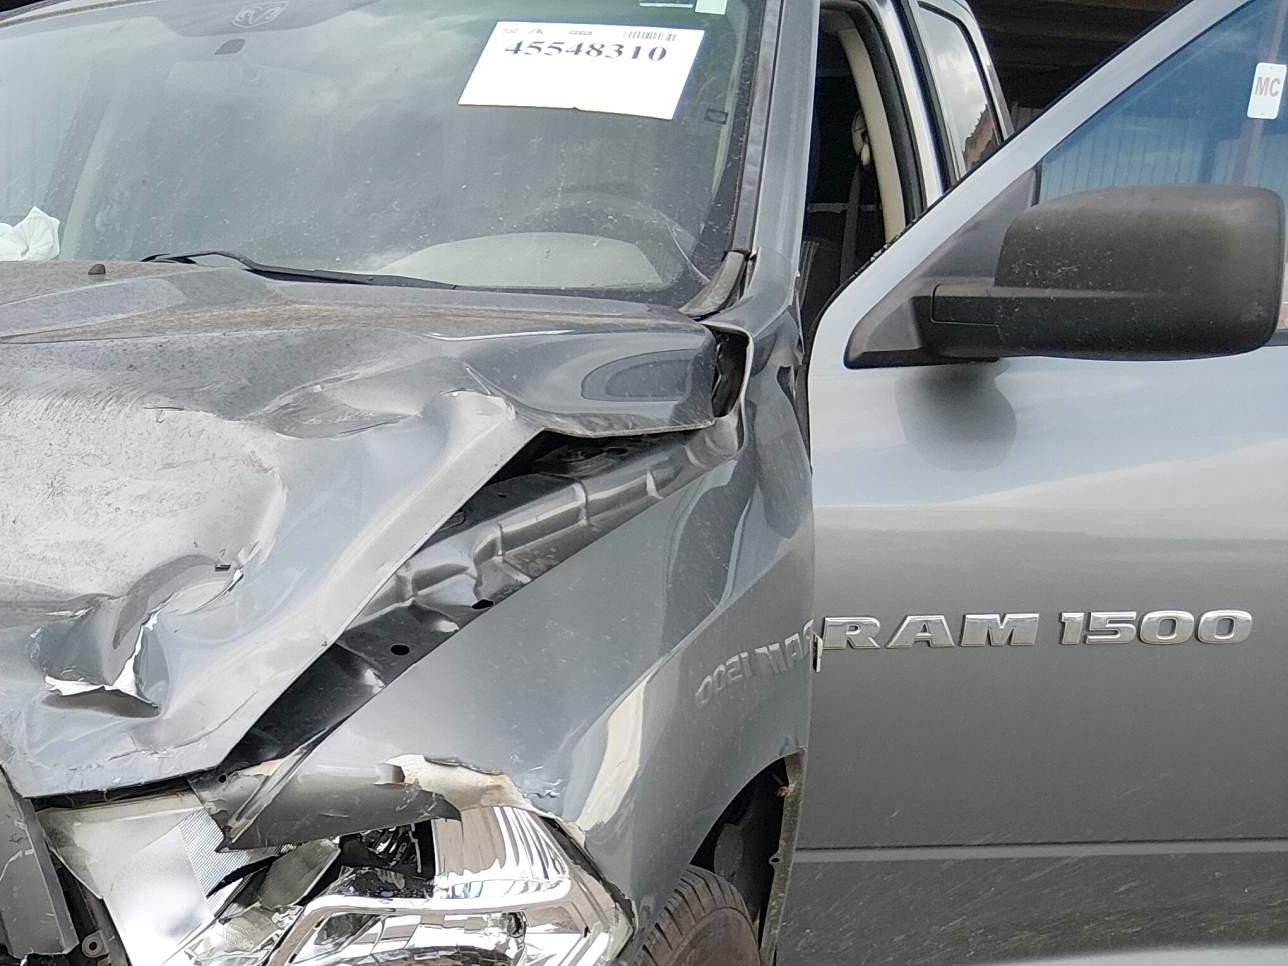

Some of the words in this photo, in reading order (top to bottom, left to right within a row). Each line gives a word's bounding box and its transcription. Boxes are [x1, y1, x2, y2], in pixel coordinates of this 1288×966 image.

[504, 40, 667, 62] 45548310
[822, 613, 1040, 650] RAM
[1059, 609, 1253, 646] 1500
